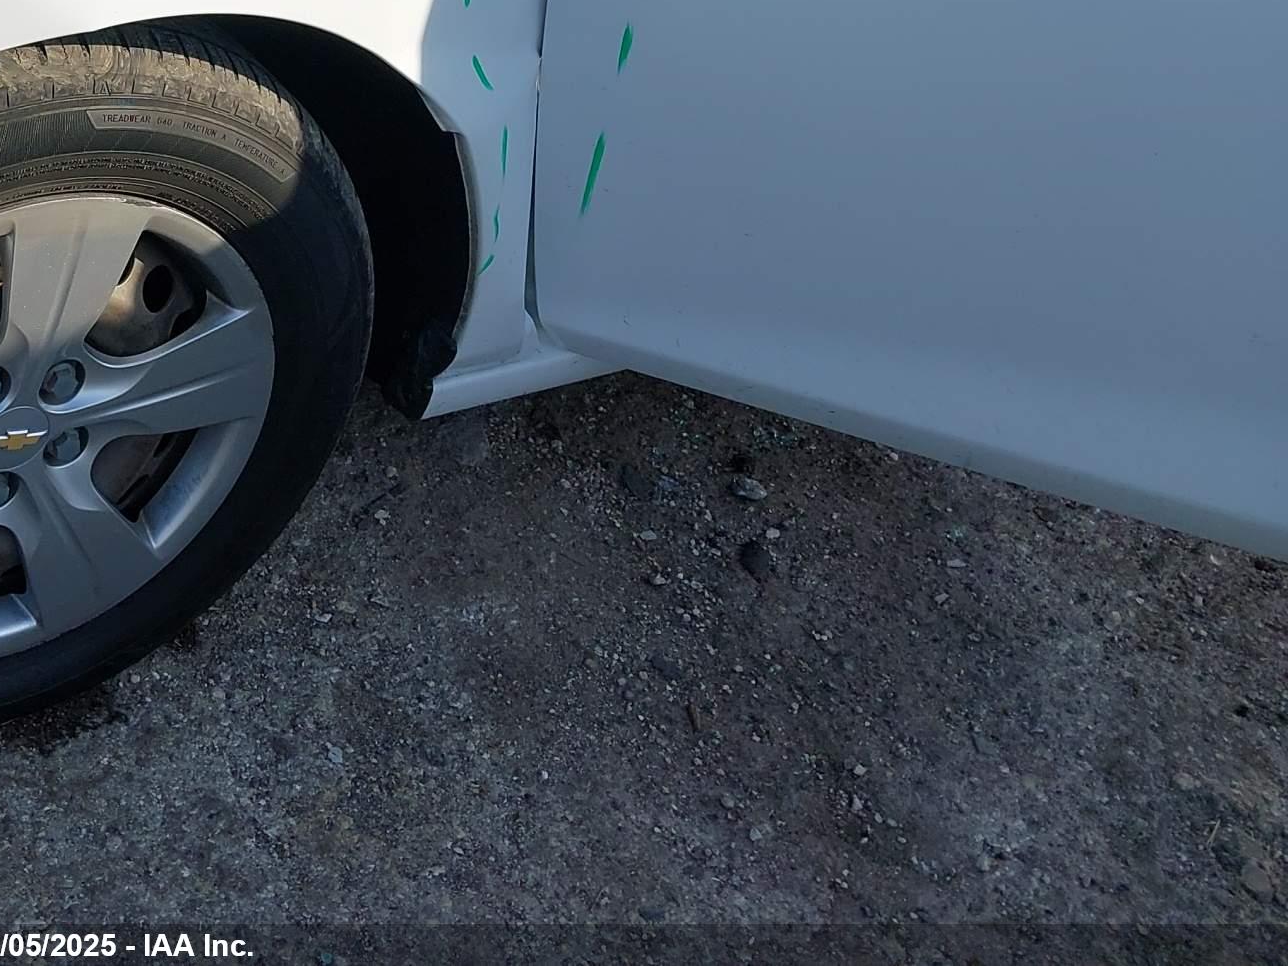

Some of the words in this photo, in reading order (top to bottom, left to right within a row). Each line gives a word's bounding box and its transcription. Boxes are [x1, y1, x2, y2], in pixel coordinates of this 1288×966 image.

[102, 113, 151, 124] TREADWEAR
[182, 121, 217, 138] TRACTION
[234, 138, 279, 168] TEMPERATURE
